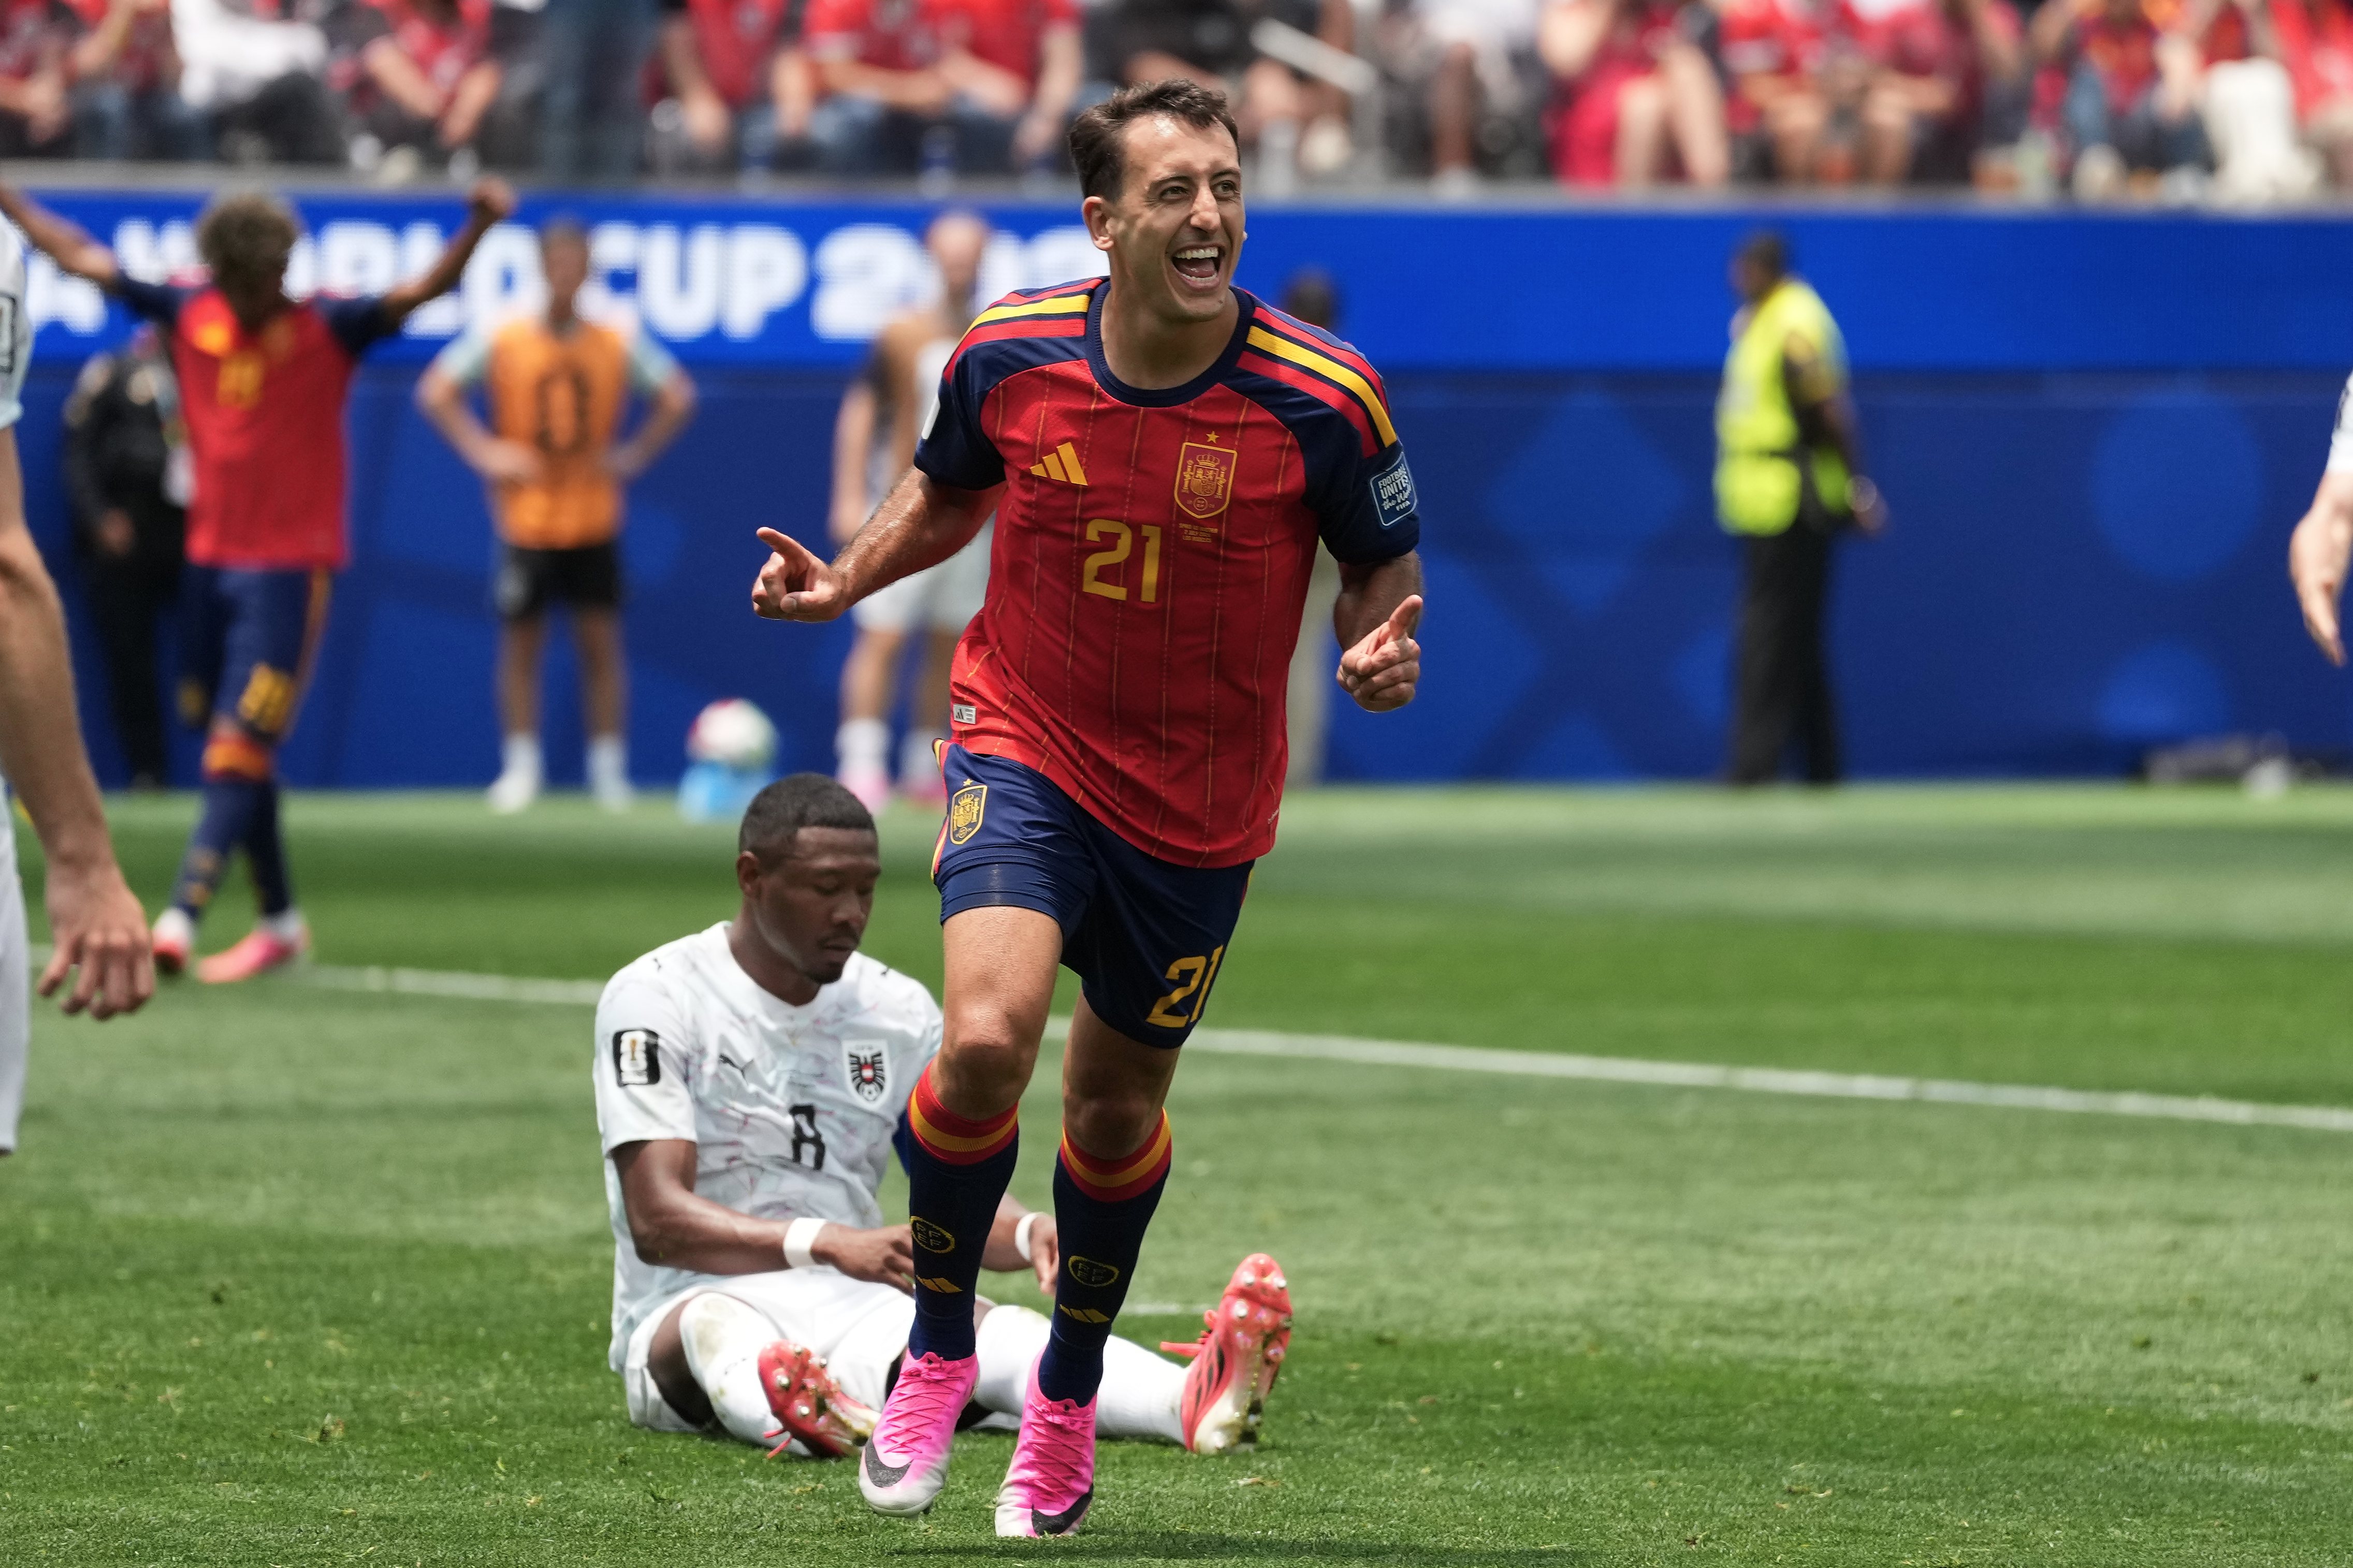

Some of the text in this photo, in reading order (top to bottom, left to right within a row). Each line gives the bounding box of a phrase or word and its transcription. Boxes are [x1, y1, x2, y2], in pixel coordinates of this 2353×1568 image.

[572, 220, 809, 342] CUP
[1082, 518, 1161, 603] 21
[1145, 944, 1224, 1029] 21
